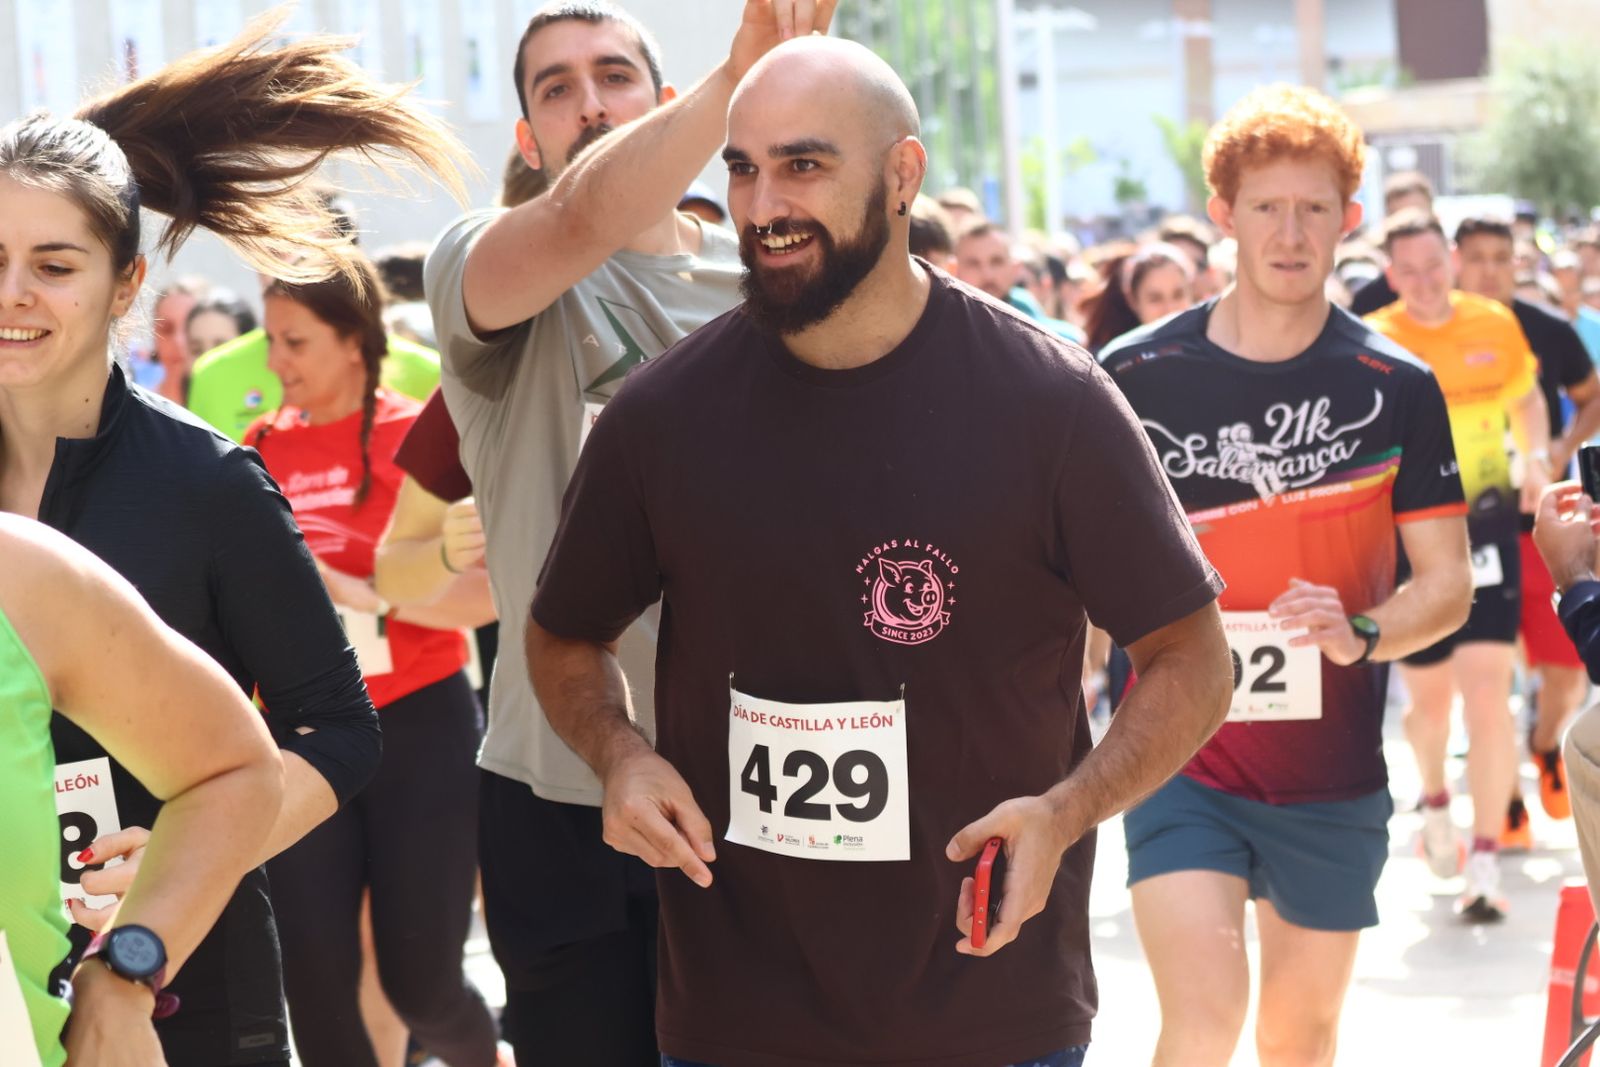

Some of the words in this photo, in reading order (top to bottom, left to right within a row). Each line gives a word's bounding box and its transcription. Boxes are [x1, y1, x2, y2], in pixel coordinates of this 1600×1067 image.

[1265, 396, 1336, 449] 21k
[1163, 433, 1361, 484] Salamanca
[856, 539, 898, 574] NALGAS
[904, 539, 919, 548] AL
[925, 543, 959, 574] FALLO
[882, 626, 908, 640] SINCE
[910, 626, 934, 641] 2023
[733, 704, 748, 721] DÍA
[750, 711, 770, 725] DE
[769, 714, 833, 731] CASTILLA
[837, 717, 847, 730] Y
[851, 712, 893, 729] LEÓN
[55, 774, 99, 794] LEÓN
[741, 743, 889, 823] 429
